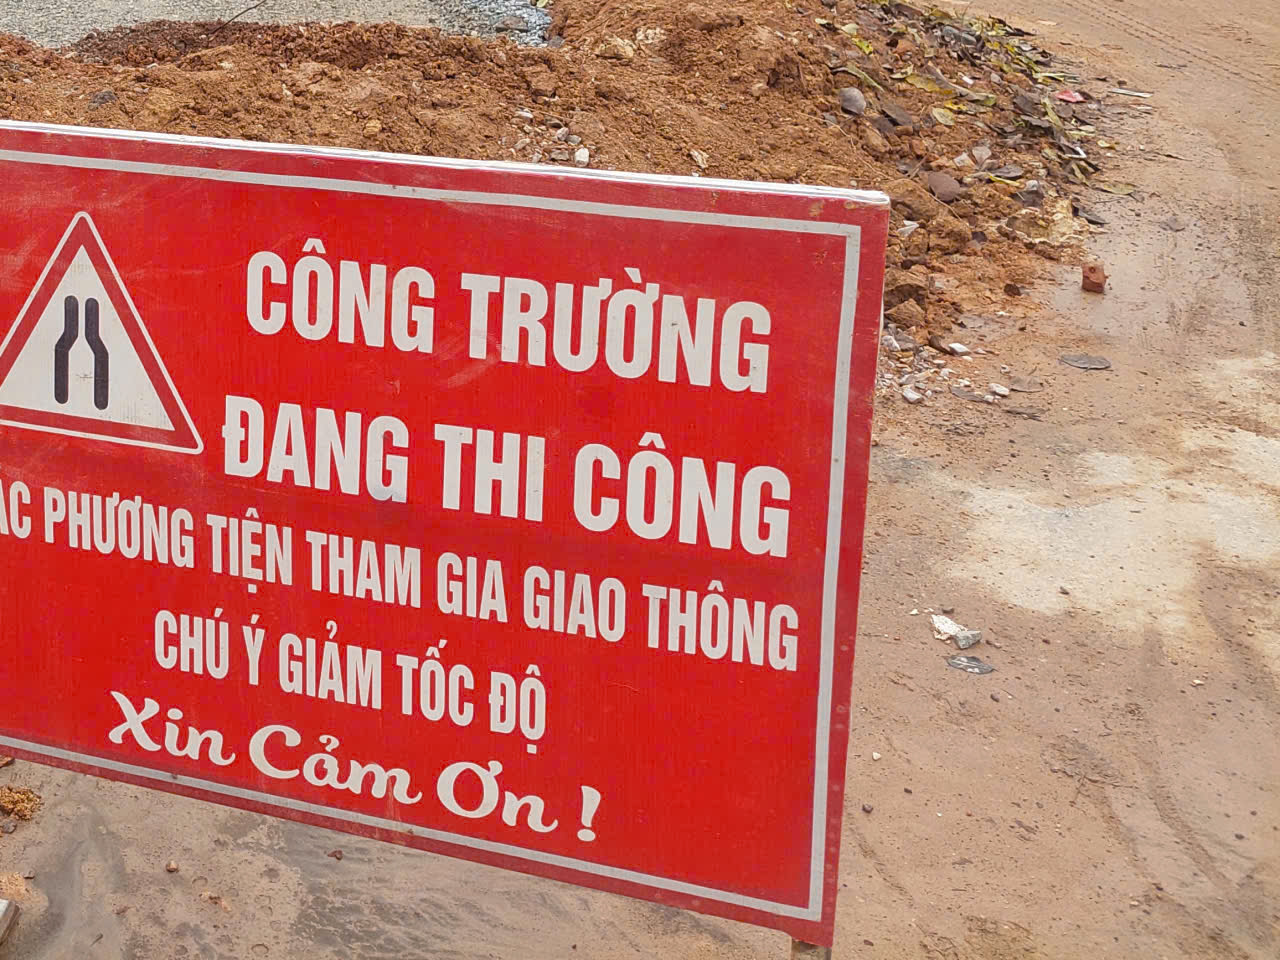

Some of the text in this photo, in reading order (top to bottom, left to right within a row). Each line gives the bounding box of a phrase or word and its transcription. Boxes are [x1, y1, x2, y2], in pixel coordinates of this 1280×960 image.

[247, 238, 771, 393] CÔNG TRƯỜNG
[222, 395, 790, 557] ĐANG THI CÔNG
[44, 487, 194, 568] PHƯƠNG
[207, 508, 292, 593] TIỆN
[306, 530, 420, 608] THAM
[438, 552, 507, 622] GIA
[524, 566, 626, 642] GIAO
[642, 580, 798, 671] THÔNG
[155, 605, 546, 754] CHÚ Ý GIẢM TỐC ĐỘ
[109, 691, 601, 841] Xin Cảm Ơn !
